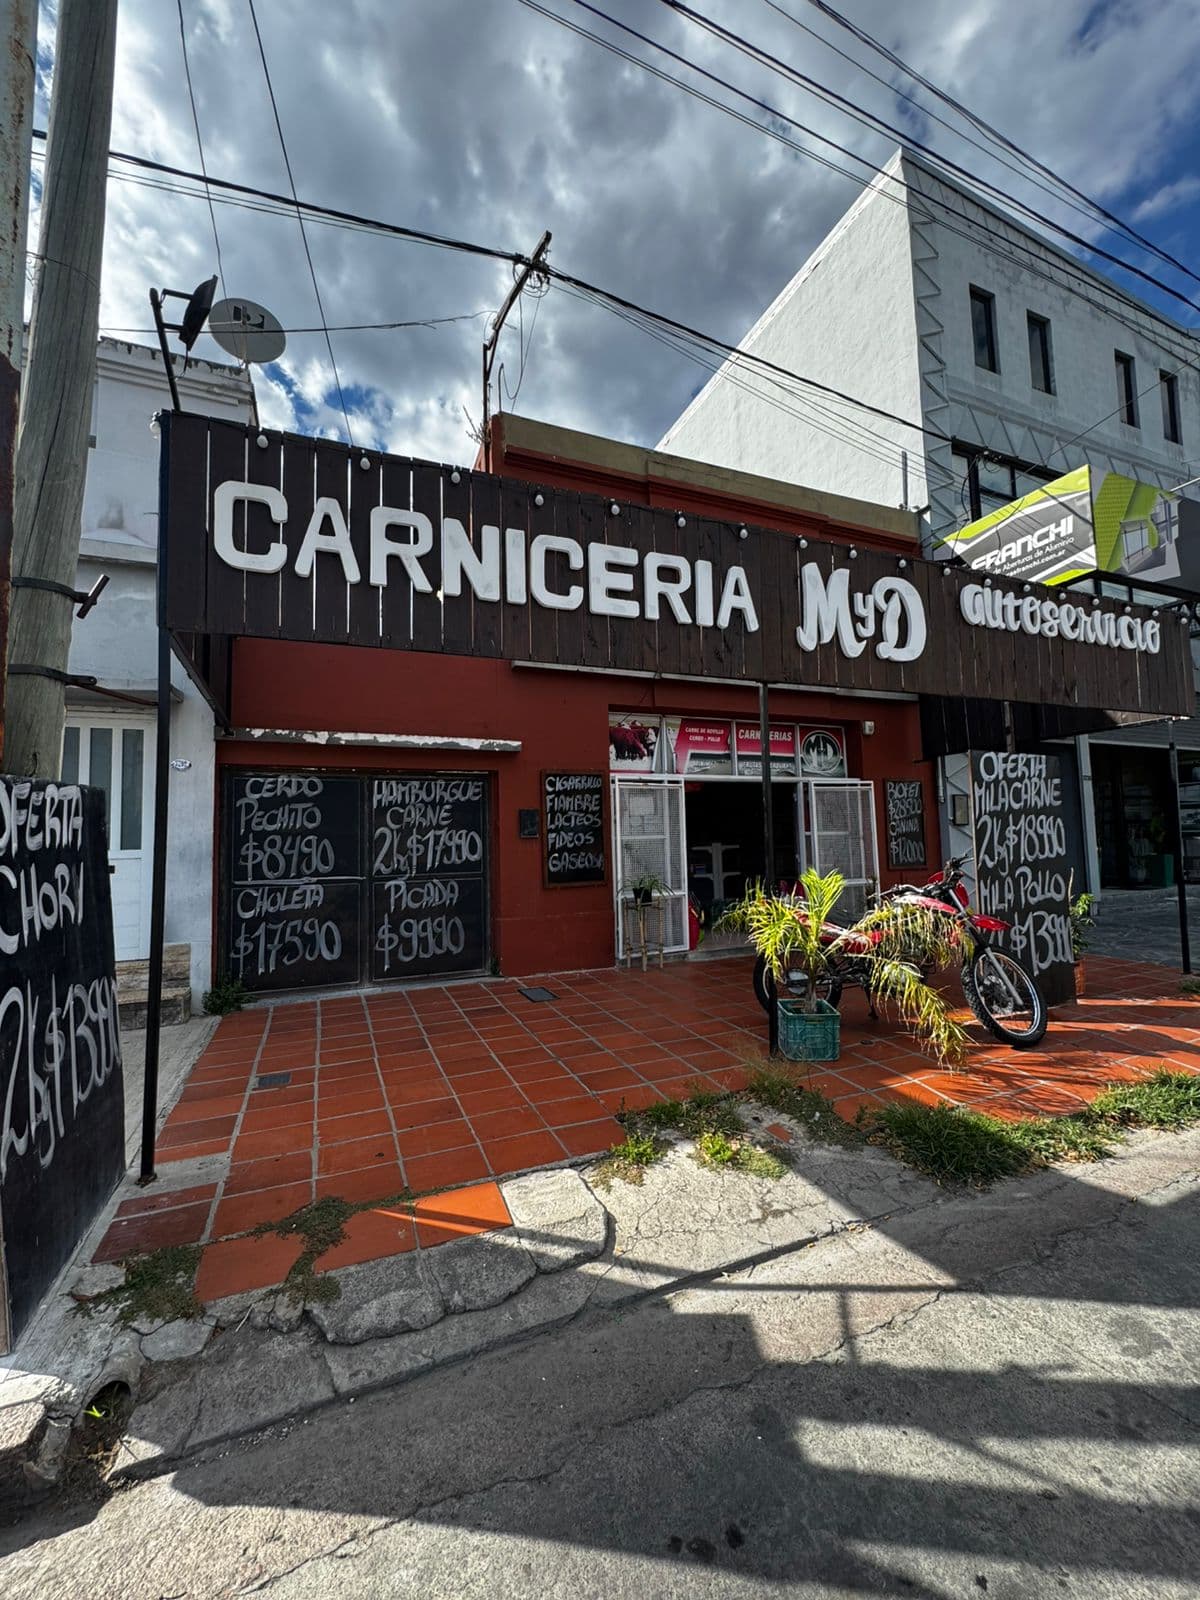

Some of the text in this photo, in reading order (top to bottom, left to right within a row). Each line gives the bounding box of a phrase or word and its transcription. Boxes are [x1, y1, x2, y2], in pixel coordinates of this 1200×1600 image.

[1034, 548, 1044, 559] de
[1044, 536, 1075, 553] Aluminio
[213, 480, 927, 663] CARNICERIA MyD
[960, 583, 1161, 654] autoservicio
[738, 729, 793, 742] CARNERIAS
[980, 752, 1047, 781] OFERTA
[245, 776, 323, 799] CERDO
[374, 780, 483, 808] HAMBURGUE
[236, 798, 321, 835] PECHITO
[387, 804, 453, 829] CARNE
[546, 794, 600, 812] FIAMBRE
[547, 811, 602, 829] LACTEOS
[548, 831, 594, 851] FIDEOS
[239, 833, 335, 881] $8490
[385, 879, 459, 913] PICADA
[980, 866, 1066, 914] MILA POLLO
[230, 918, 342, 978] $17590
[375, 913, 465, 972] $9990
